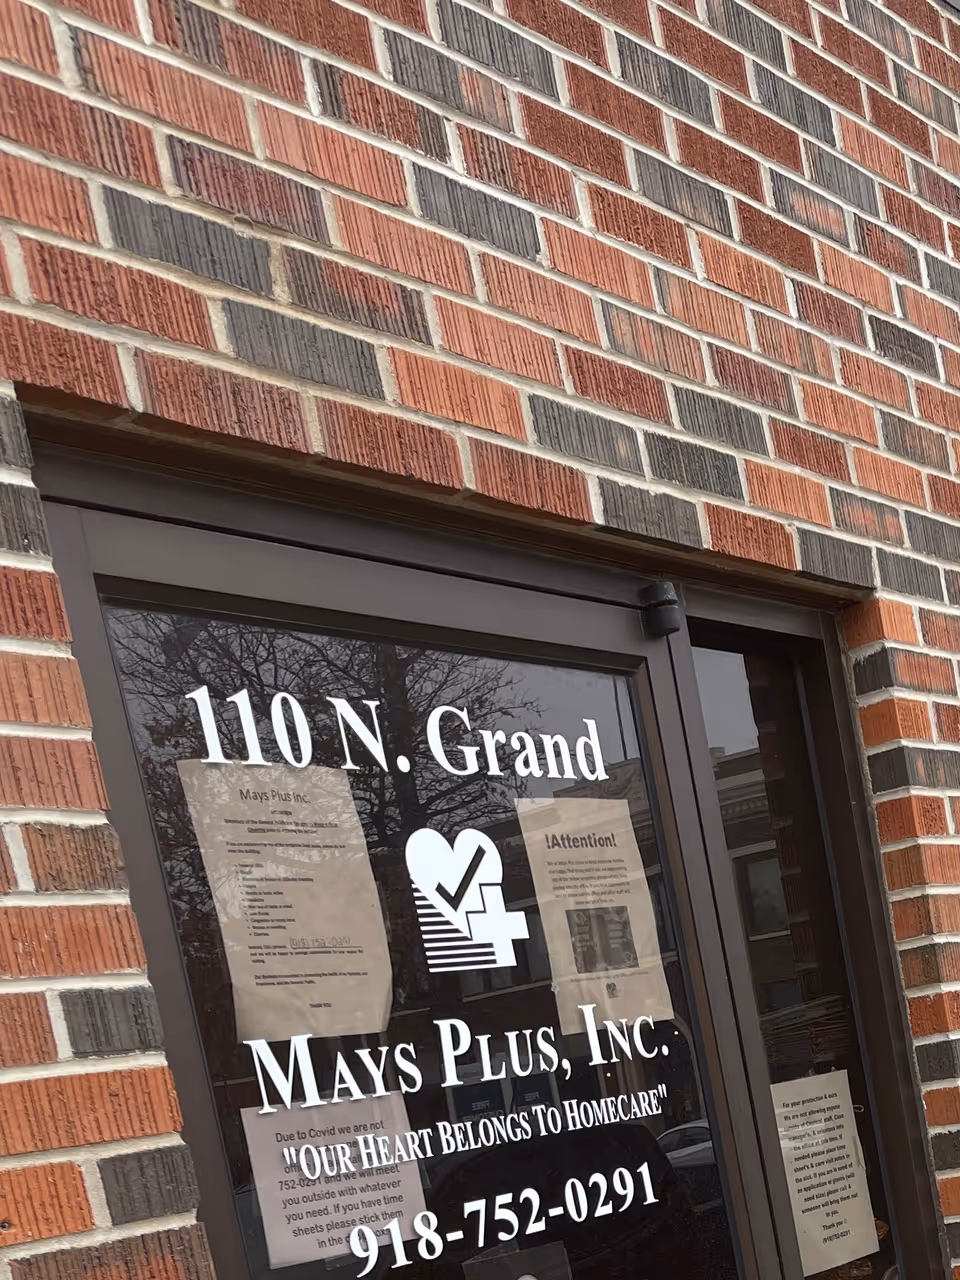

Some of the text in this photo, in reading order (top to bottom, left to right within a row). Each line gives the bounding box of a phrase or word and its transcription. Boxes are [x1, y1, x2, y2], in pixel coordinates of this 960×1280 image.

[185, 685, 609, 781] 110 N. Grand
[238, 788, 270, 806] Mays
[270, 789, 291, 802] Plus
[544, 833, 617, 849] !Attention!
[243, 1003, 669, 1114] MAYS PLUS, INC.
[274, 1120, 384, 1142] Due to Covid we are not
[283, 1144, 353, 1180] "OUR
[360, 1128, 434, 1172] HEART
[436, 1115, 532, 1156] BELONGS
[532, 1104, 562, 1135] TO
[565, 1083, 668, 1131] HOMECARE"
[343, 1171, 357, 1180] we
[374, 1163, 399, 1175] meet
[281, 1177, 402, 1208] you outside with whatever
[285, 1193, 403, 1224] you need. If you have time
[291, 1207, 403, 1237] sheets please stick them
[349, 1162, 659, 1279] 918-752-0291
[317, 1237, 326, 1248] in
[327, 1234, 343, 1246] the
